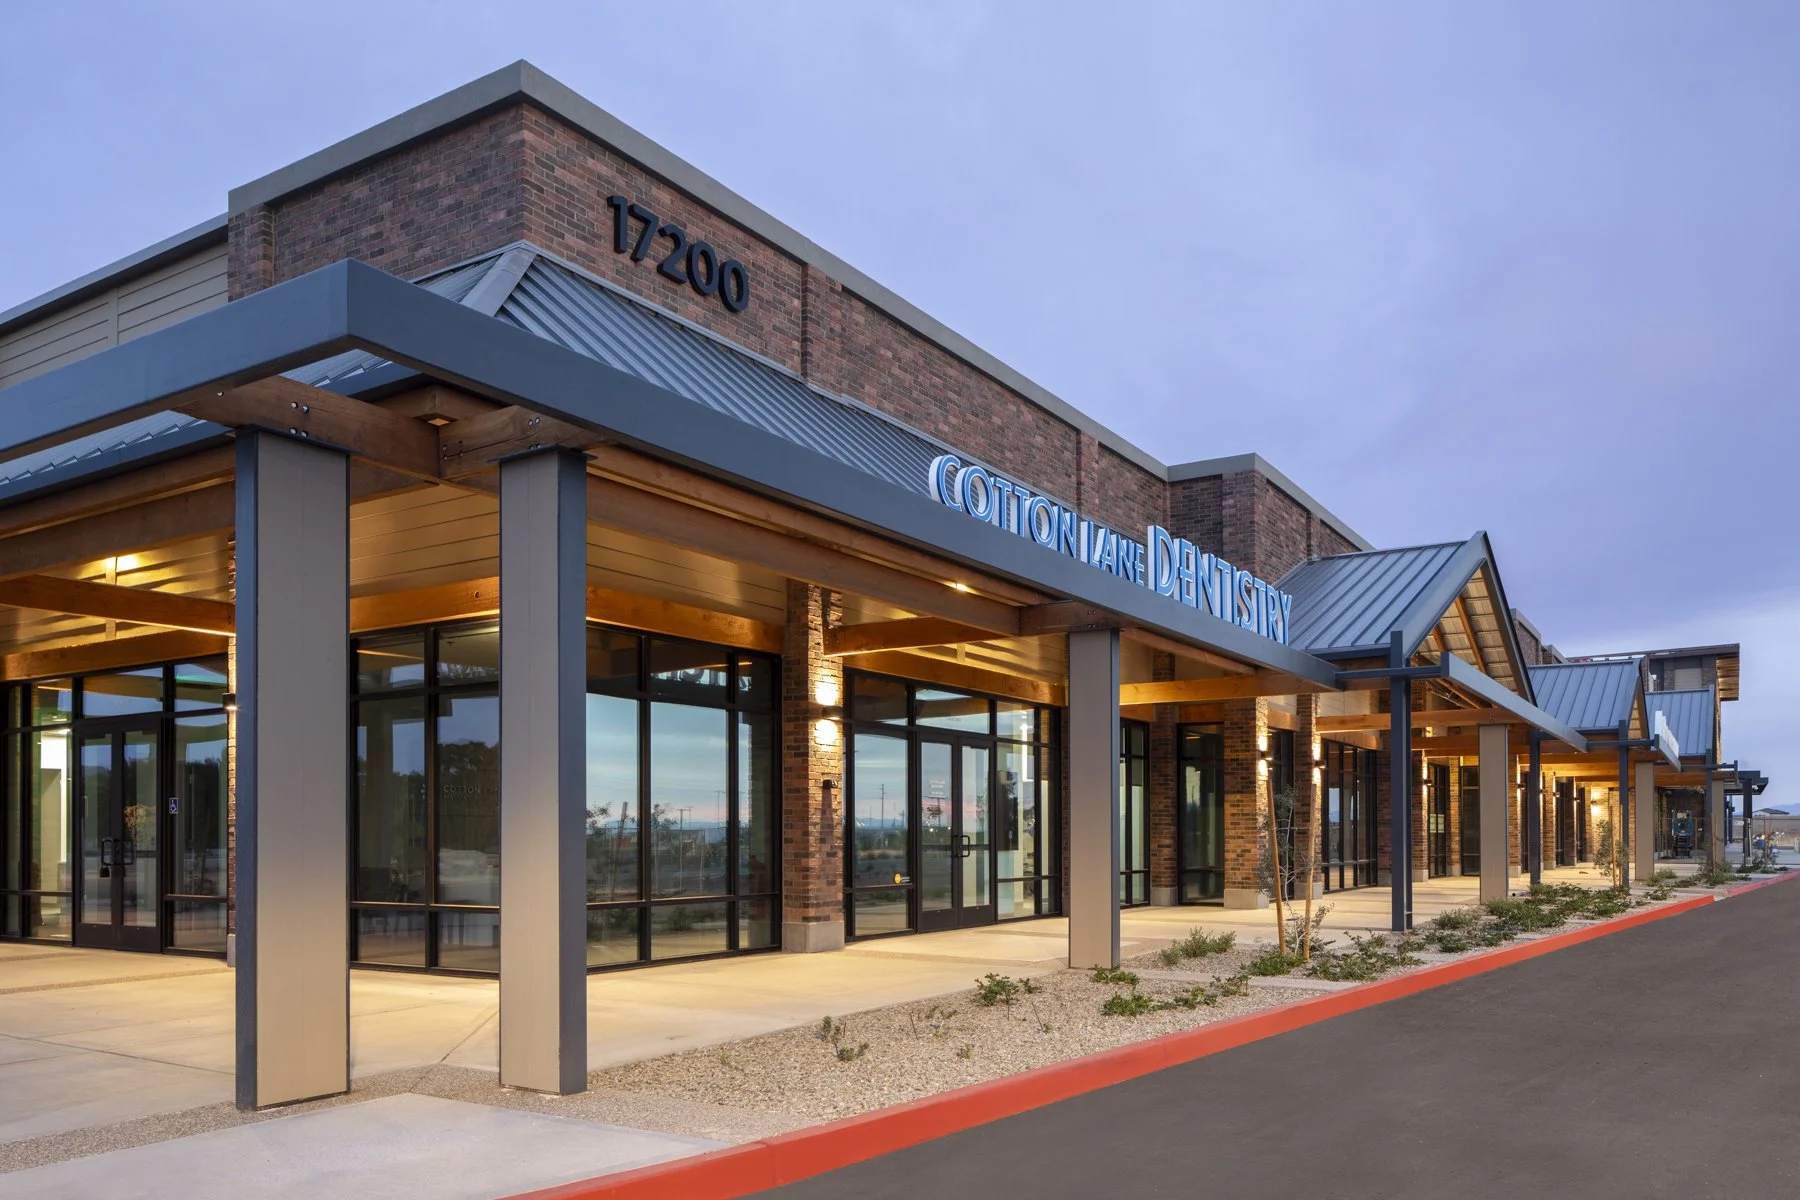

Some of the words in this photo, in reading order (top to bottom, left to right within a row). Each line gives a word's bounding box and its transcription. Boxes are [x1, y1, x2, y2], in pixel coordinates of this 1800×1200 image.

[607, 195, 749, 313] 17200
[929, 454, 1076, 559] COTTON
[1081, 520, 1144, 587] LANE
[1147, 524, 1293, 646] DENTISTRY
